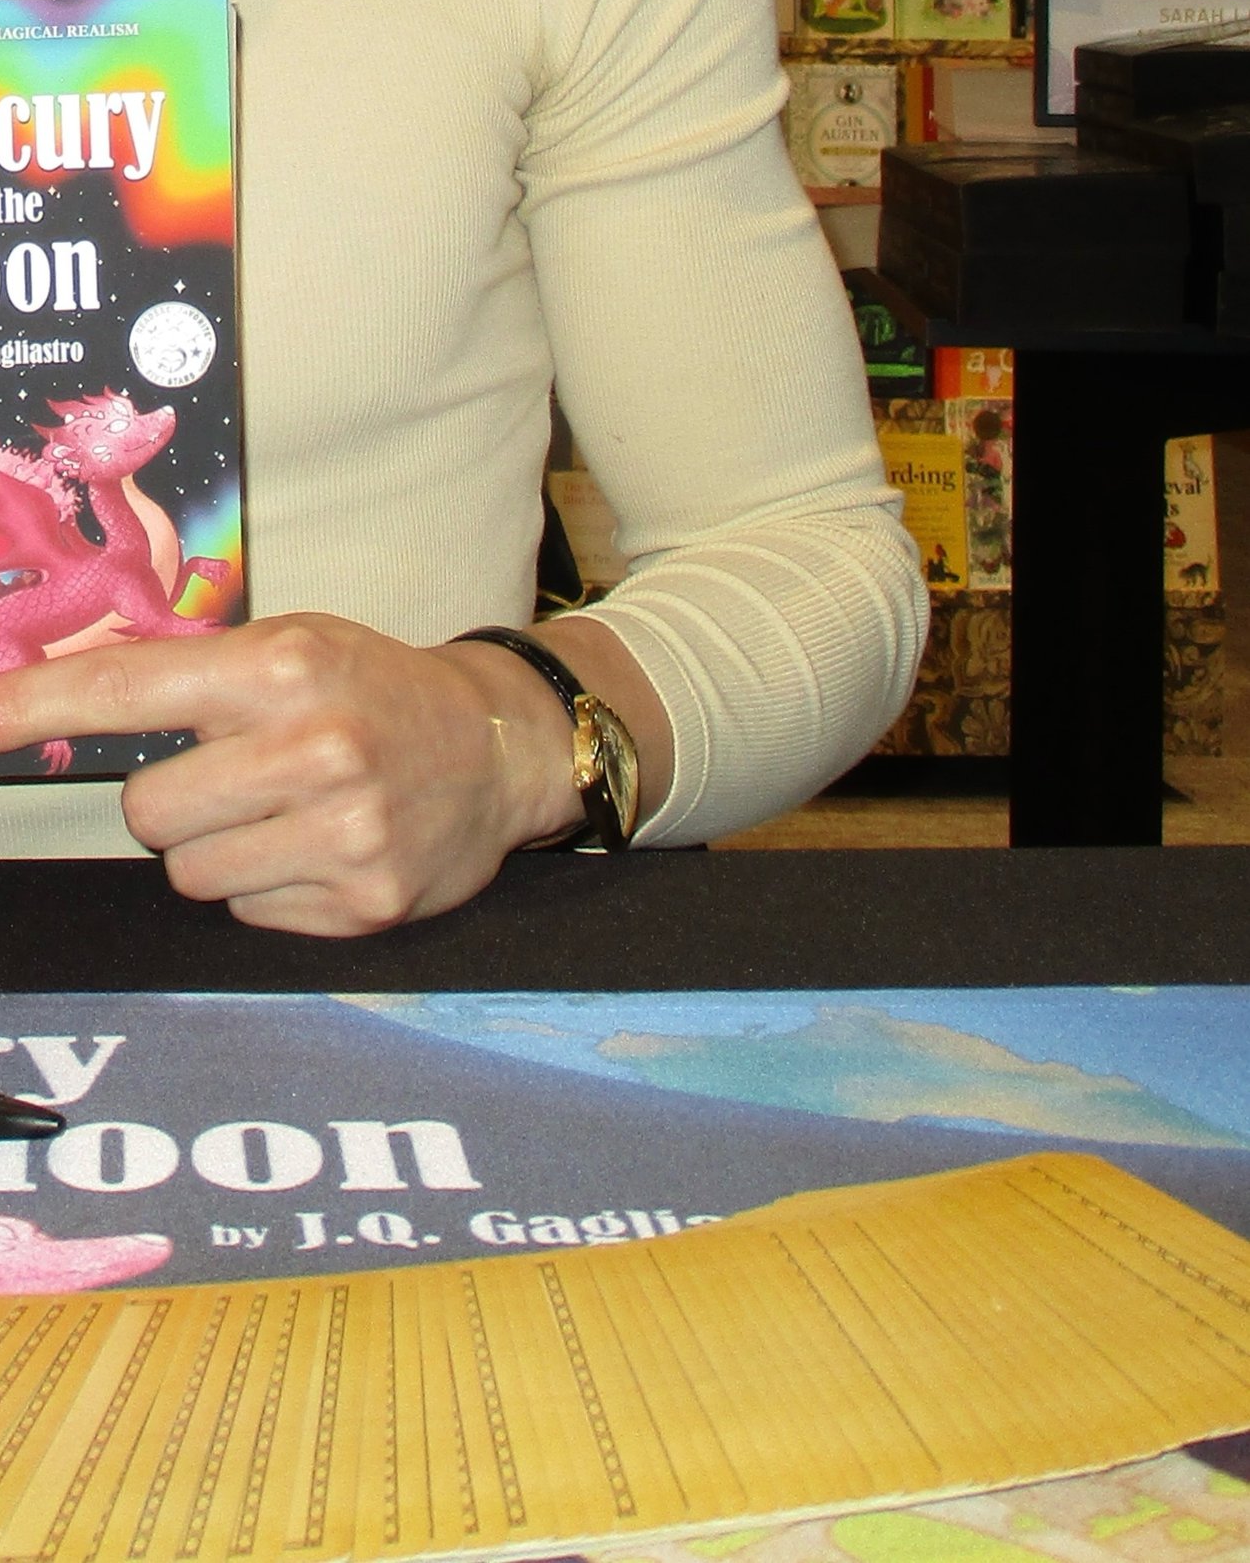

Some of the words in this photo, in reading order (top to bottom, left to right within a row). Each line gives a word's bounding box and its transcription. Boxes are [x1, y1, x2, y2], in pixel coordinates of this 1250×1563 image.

[1159, 8, 1224, 24] SARAH
[66, 23, 140, 38] REALISM
[820, 129, 880, 142] AUSTEN
[167, 372, 196, 386] STARS
[211, 1220, 270, 1250] by
[293, 1212, 439, 1250] J.Q.
